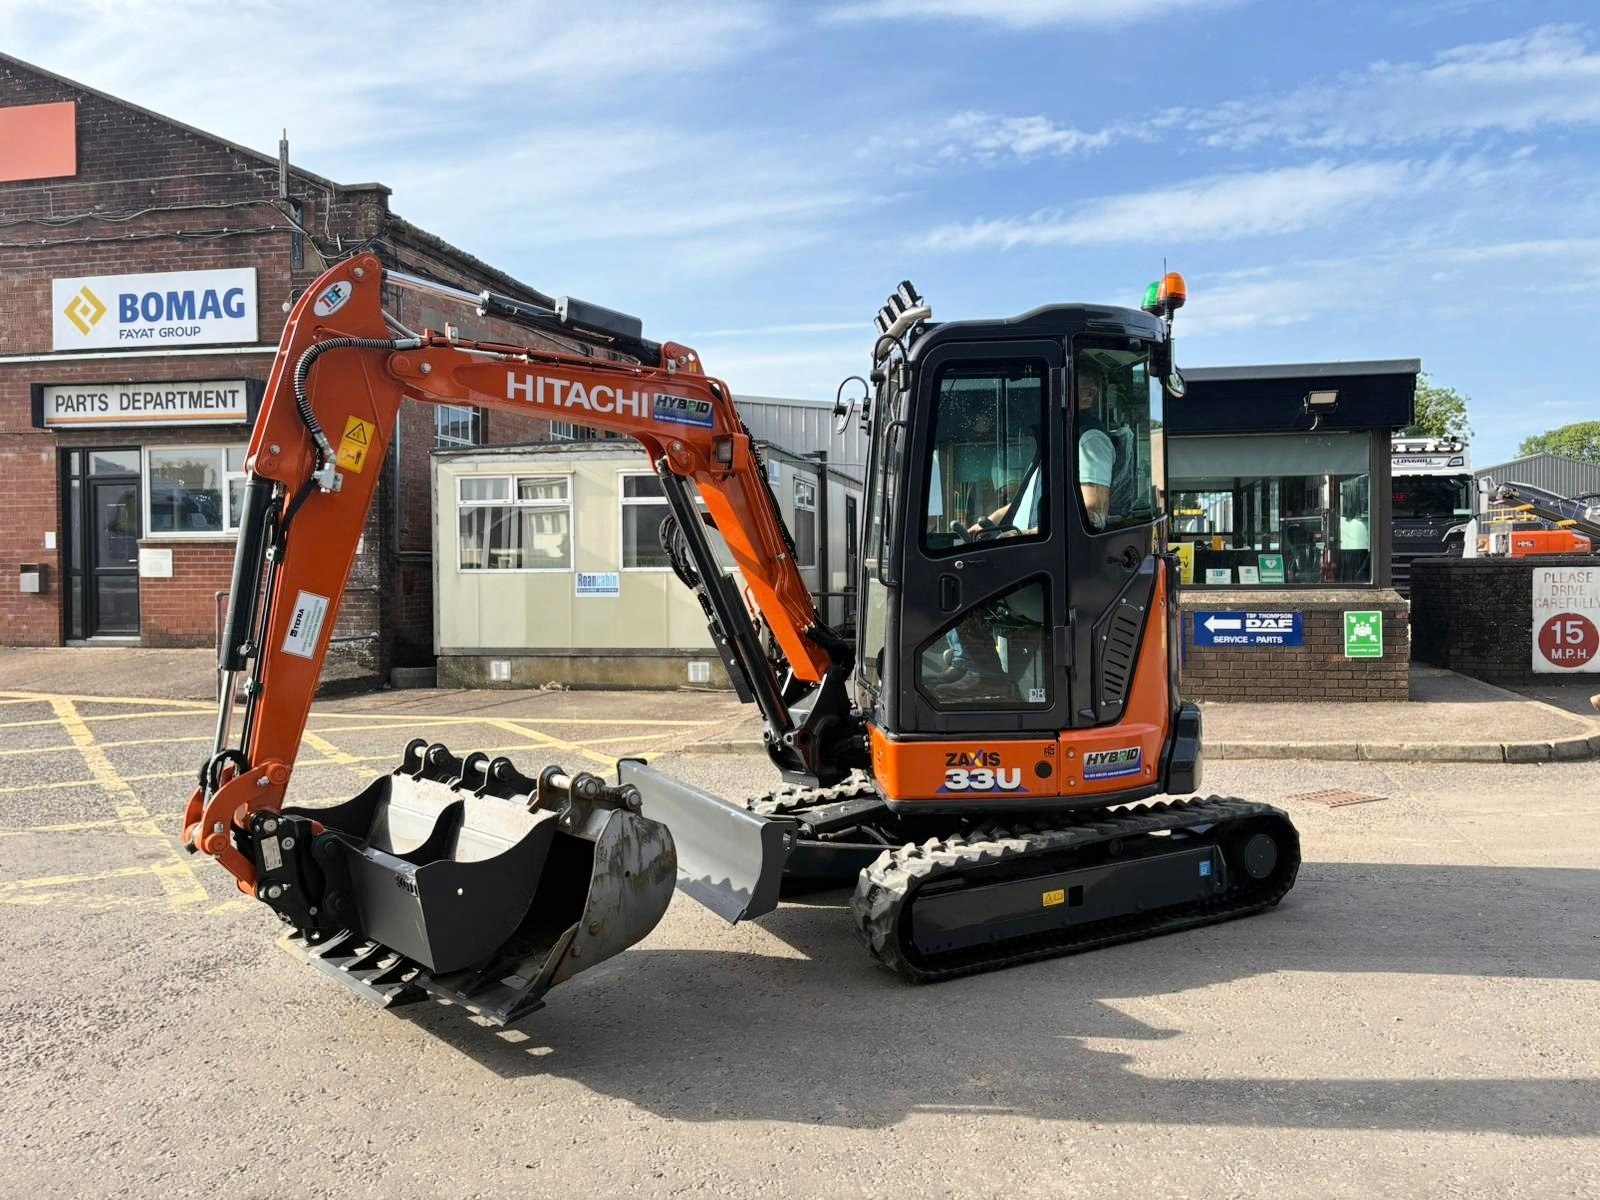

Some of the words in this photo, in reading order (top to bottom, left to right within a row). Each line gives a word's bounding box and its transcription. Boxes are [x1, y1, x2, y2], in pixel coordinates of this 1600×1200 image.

[119, 288, 245, 323] BOMAG
[119, 328, 154, 339] FAYAT
[159, 326, 201, 338] GROUP
[55, 393, 109, 413] PARTS
[120, 390, 239, 411] DEPARTMENT
[507, 371, 648, 418] HITACHI
[656, 395, 710, 413] HYBRID
[1544, 572, 1593, 583] PLEASE
[1552, 585, 1585, 596] DRIVE
[1246, 619, 1293, 628] DAF
[1213, 636, 1249, 644] SERVICE
[1256, 636, 1283, 644] PARTS
[1551, 620, 1584, 645] 15
[1551, 648, 1590, 659] M.P.H.
[945, 750, 1000, 767] ZAXIS
[1086, 748, 1138, 765] HYBRID
[945, 768, 1021, 790] 33U
